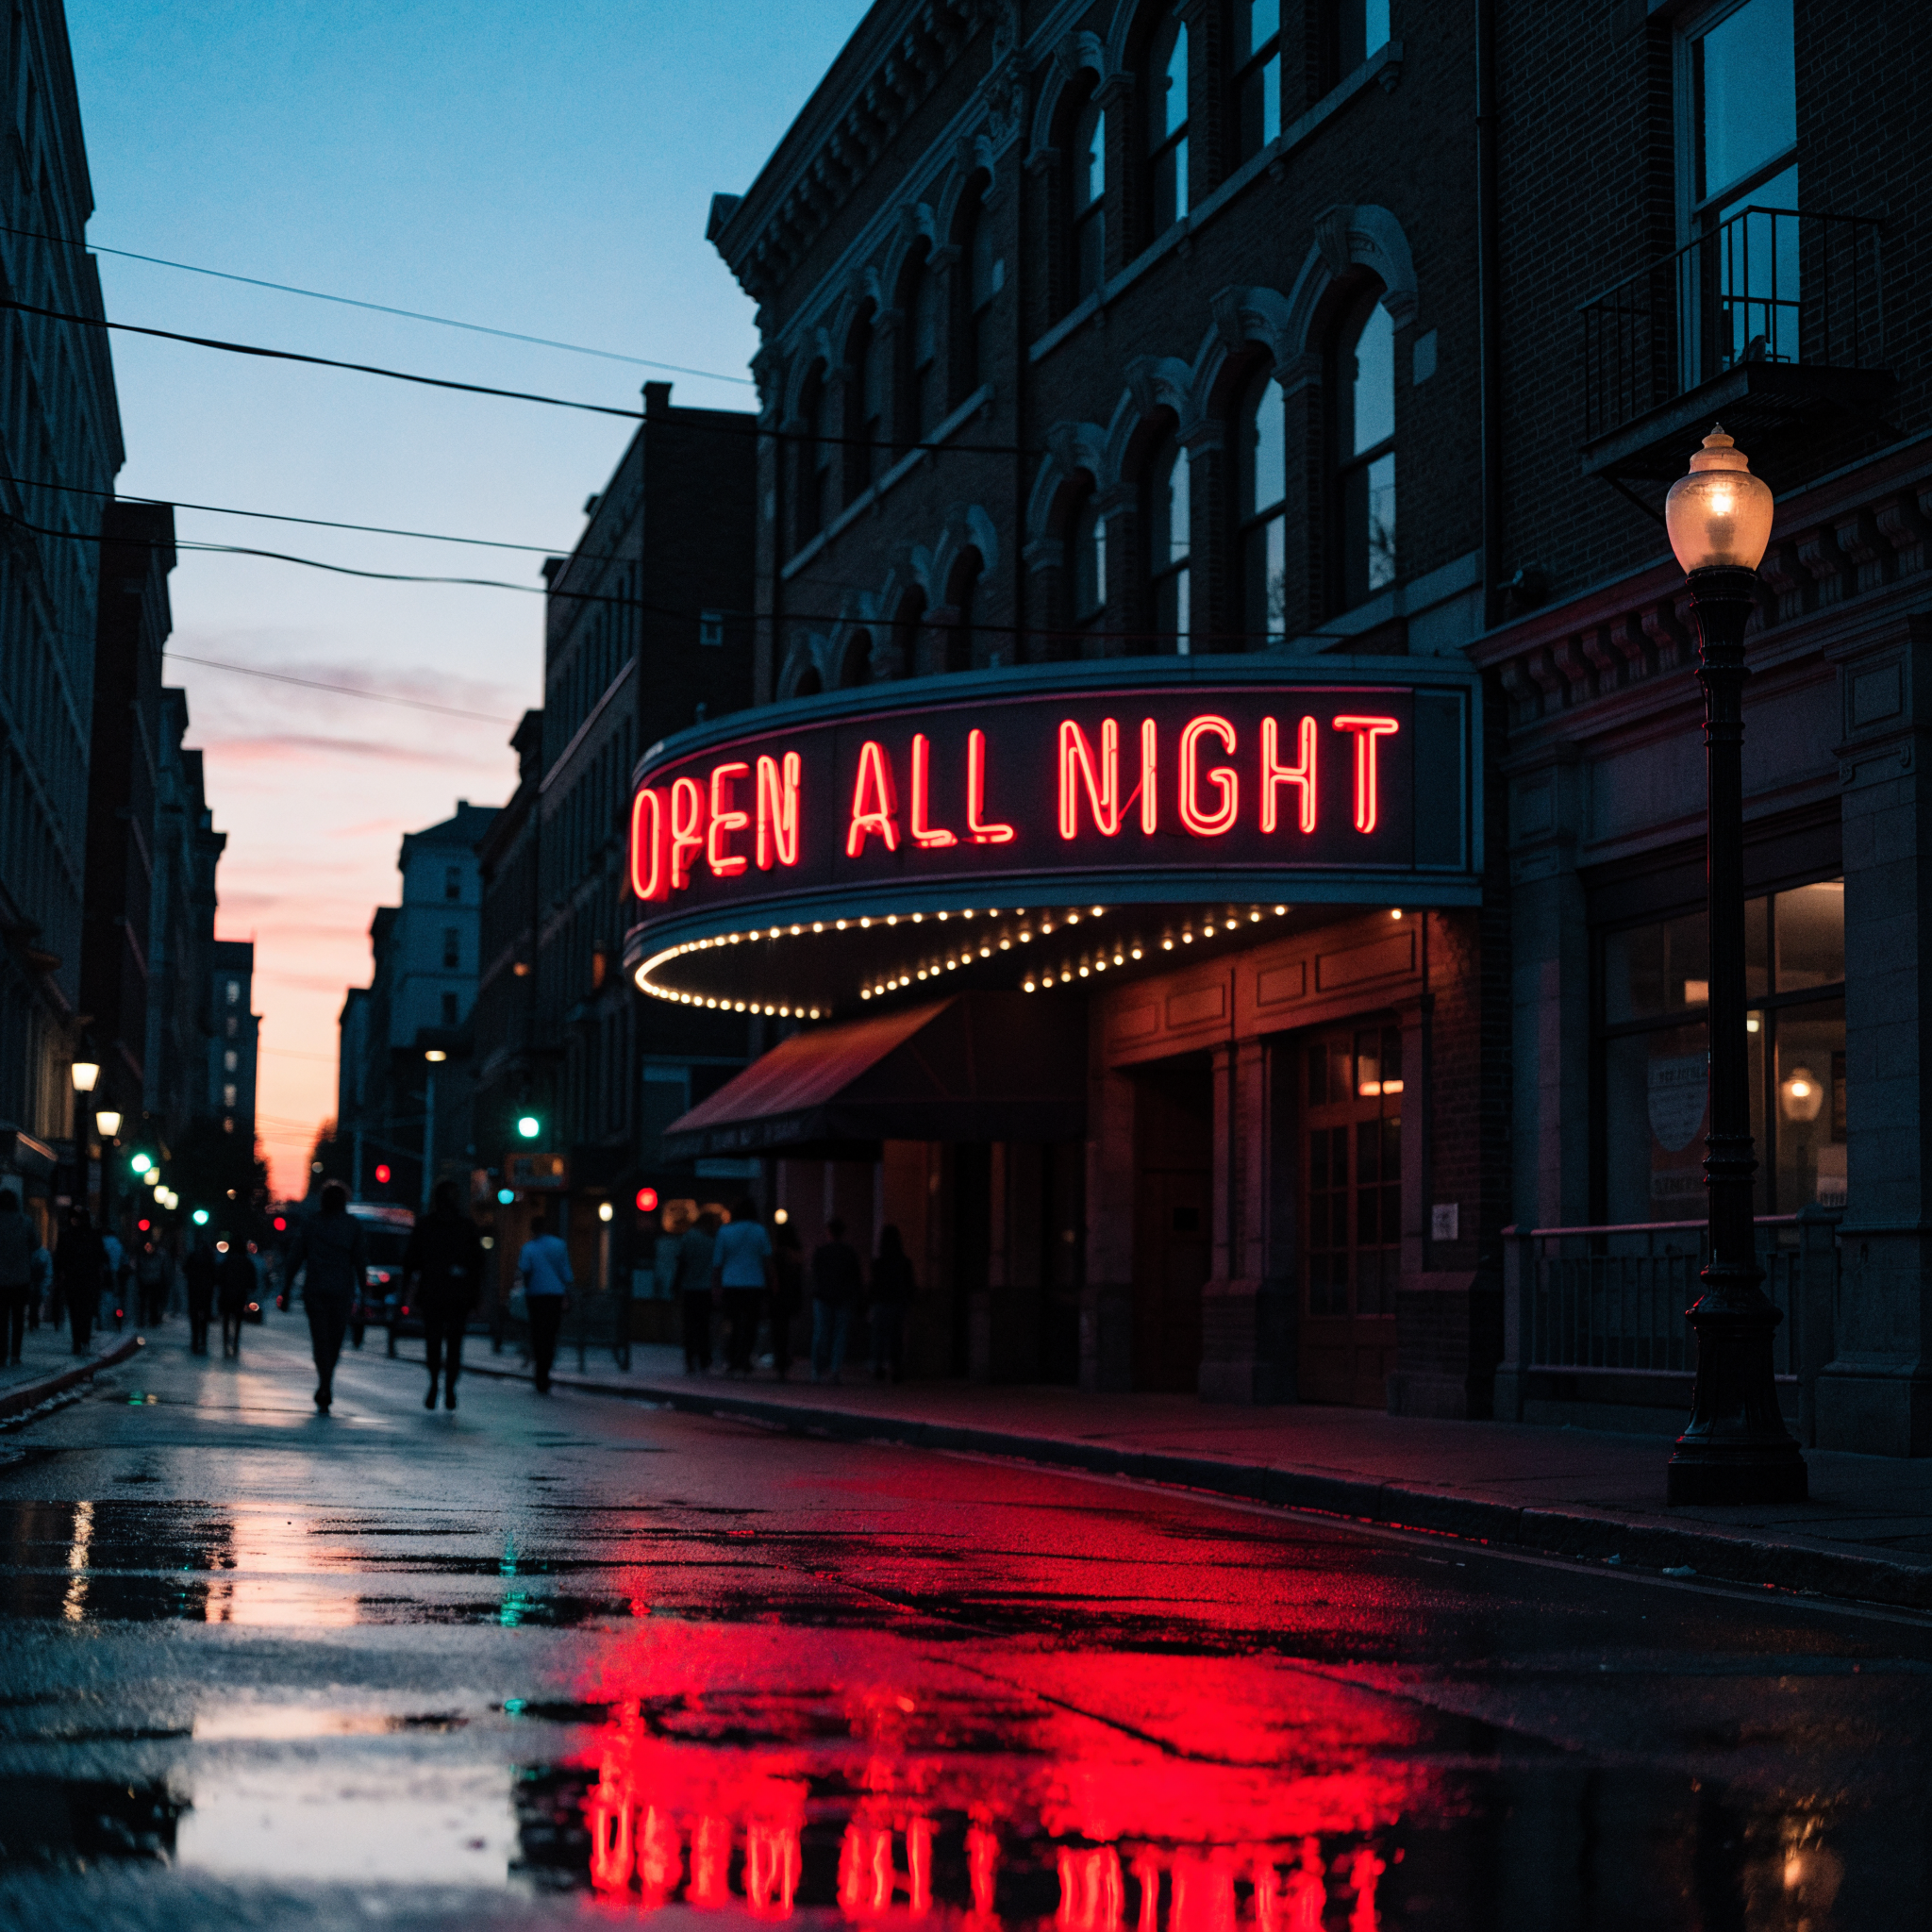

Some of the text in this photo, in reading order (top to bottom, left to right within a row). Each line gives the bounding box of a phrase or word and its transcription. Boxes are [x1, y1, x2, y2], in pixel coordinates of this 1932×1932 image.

[629, 714, 1401, 902] OPEN ALL NIGHT
